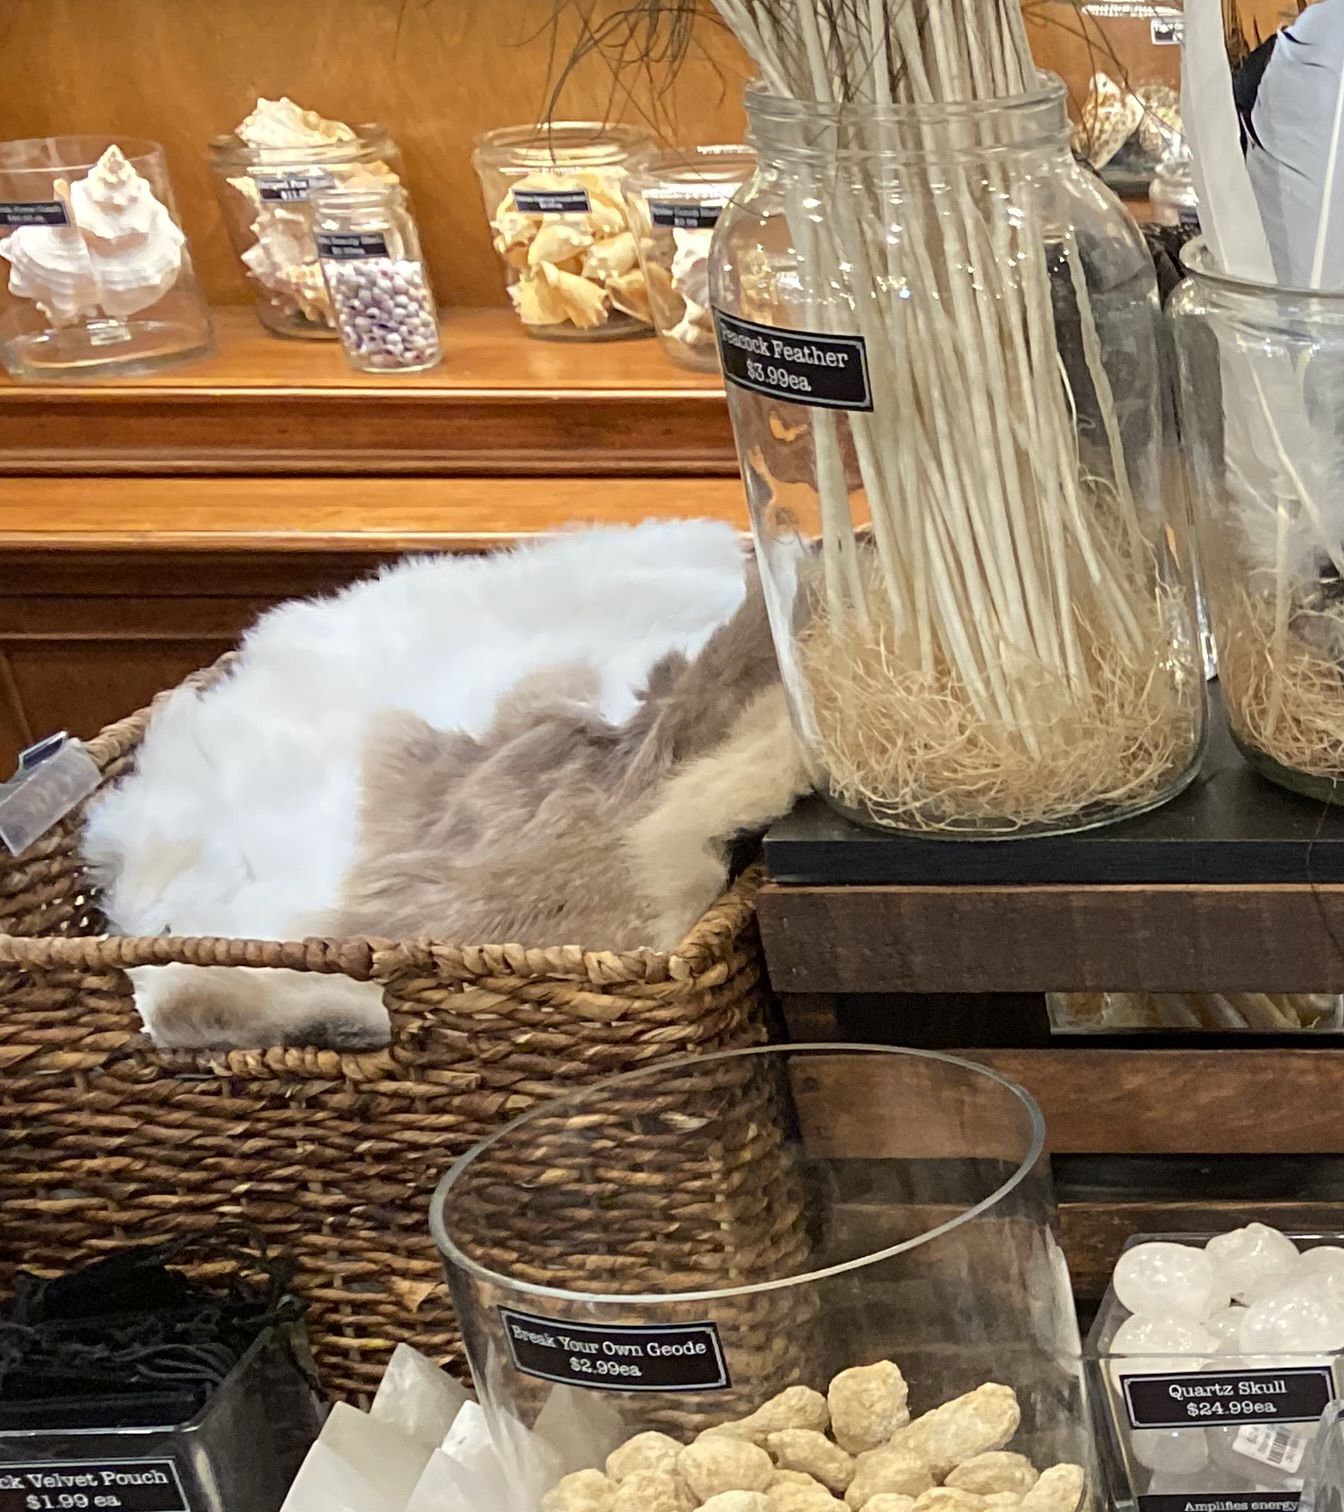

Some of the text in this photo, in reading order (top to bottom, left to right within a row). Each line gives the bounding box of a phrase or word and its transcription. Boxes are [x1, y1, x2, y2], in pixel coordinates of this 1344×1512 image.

[720, 323, 848, 368] Peacock Feather
[746, 359, 811, 392] $3.99ea
[511, 1324, 707, 1357] Break Your Own Geode
[569, 1357, 642, 1377] $2.99ea
[1169, 1380, 1287, 1400] Quartz Skull
[1187, 1401, 1277, 1417] $24.99ea
[26, 1473, 98, 1488] Velvet
[101, 1470, 168, 1486] Pouch
[26, 1494, 122, 1510] $1.99 ea
[1185, 1502, 1249, 1512] Amplifies
